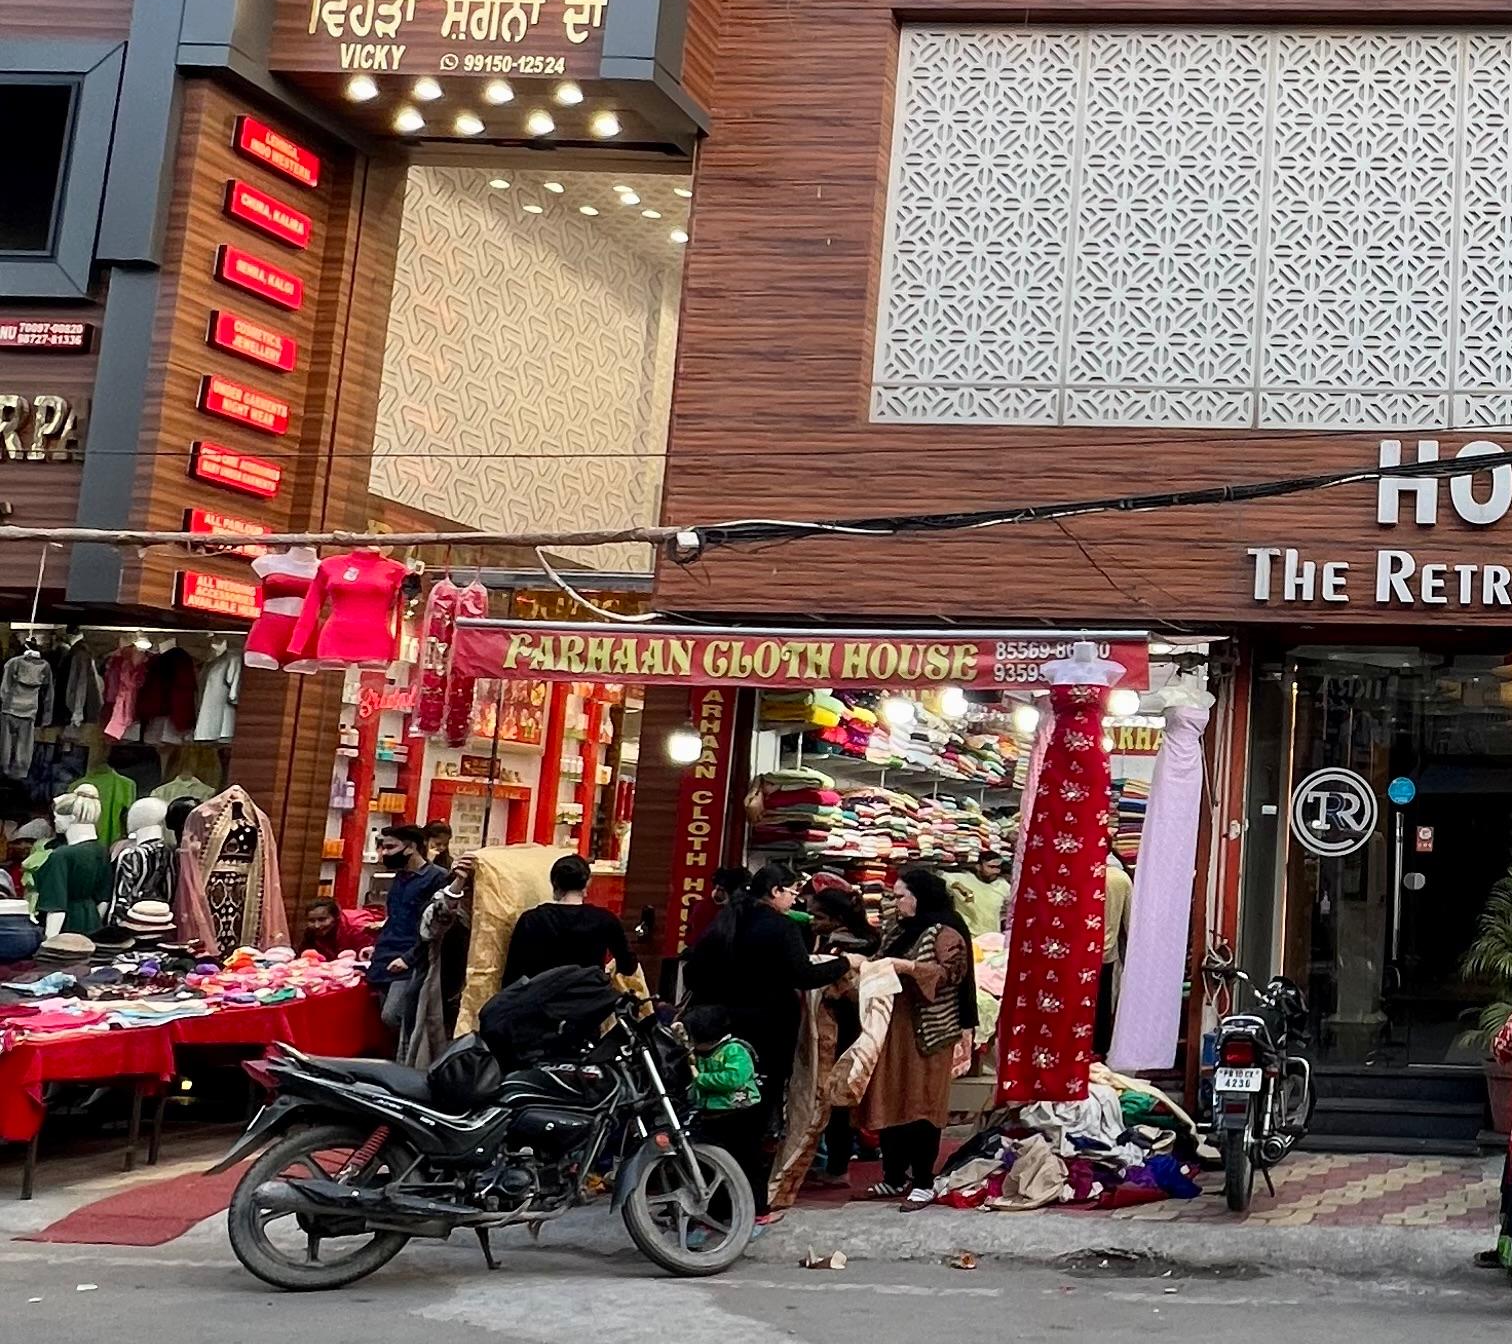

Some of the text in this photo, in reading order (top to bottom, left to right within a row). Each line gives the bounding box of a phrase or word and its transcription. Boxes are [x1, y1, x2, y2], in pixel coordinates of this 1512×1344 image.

[339, 43, 406, 71] VICKY
[463, 54, 566, 74] 99150-12524
[1247, 547, 1350, 603] THE
[503, 632, 979, 681] FARHAAN CLOTH HOUSE
[695, 689, 724, 779] ARHAAN
[686, 790, 713, 866] CLOTH
